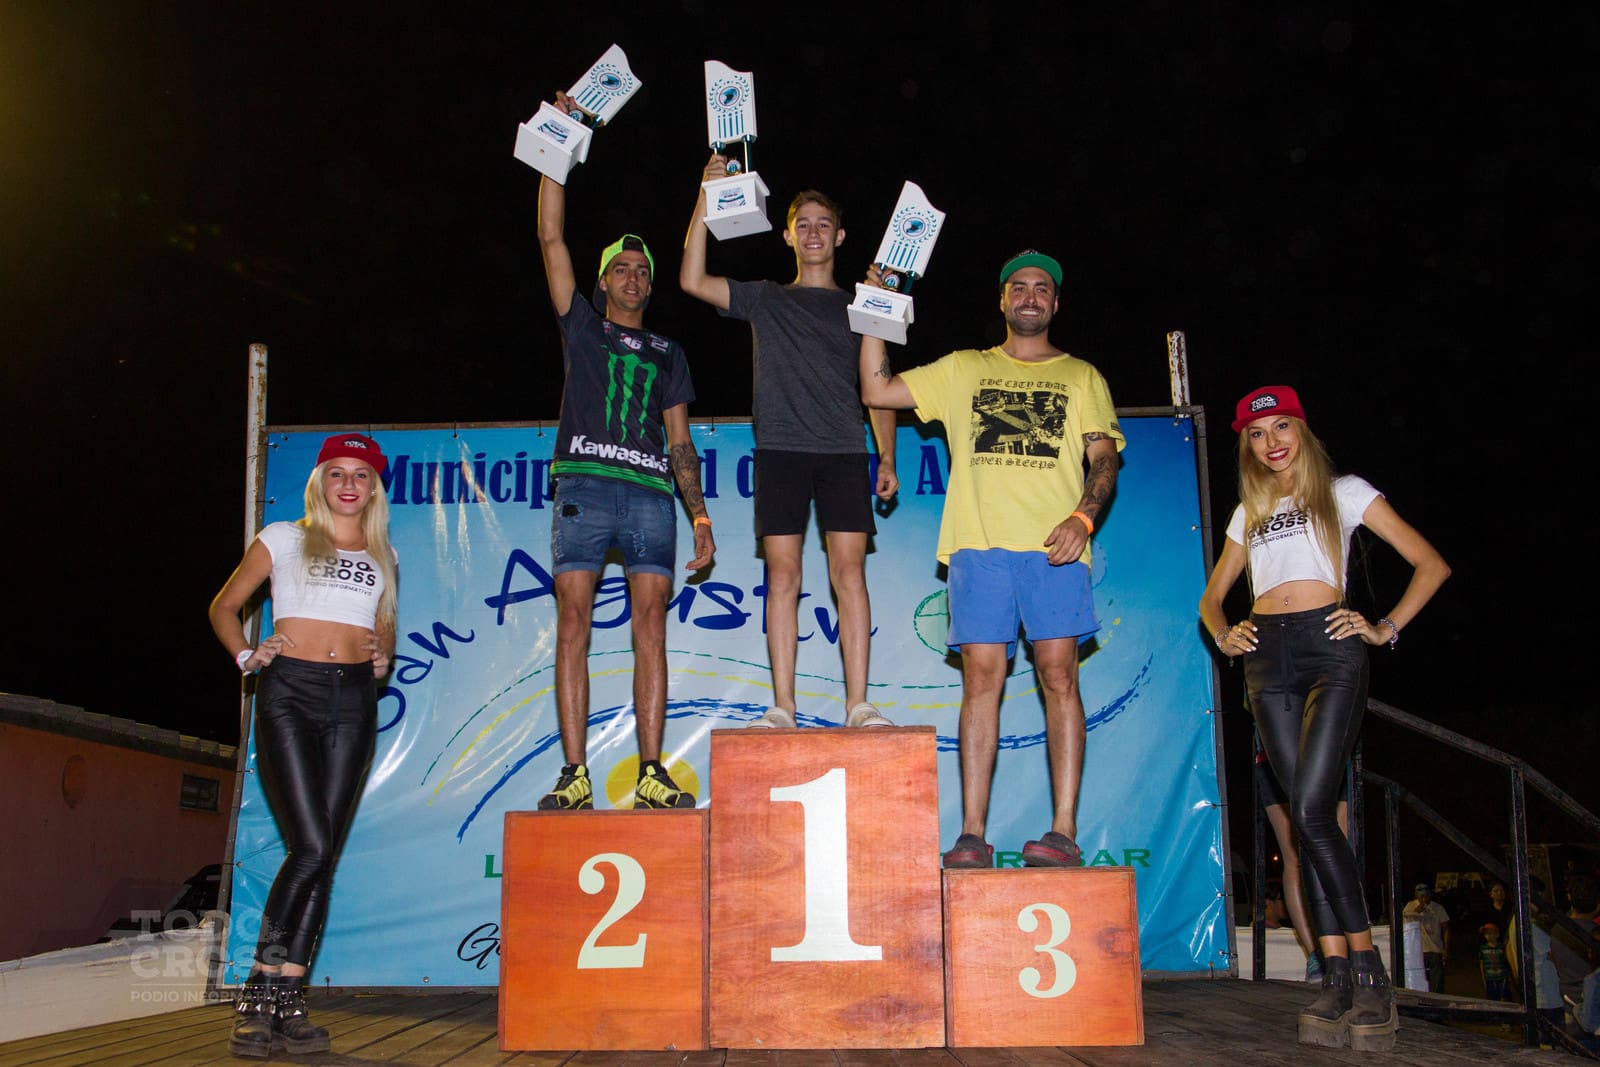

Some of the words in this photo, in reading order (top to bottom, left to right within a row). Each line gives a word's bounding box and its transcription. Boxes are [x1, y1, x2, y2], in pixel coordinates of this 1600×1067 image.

[1004, 380, 1034, 390] CITY
[1036, 381, 1069, 391] THAT
[569, 435, 669, 473] Kawasaki
[1005, 457, 1056, 470] SLEEPS
[308, 565, 376, 587] CROSS
[770, 768, 882, 961] 1
[577, 853, 647, 968] 2
[1017, 902, 1077, 998] 3
